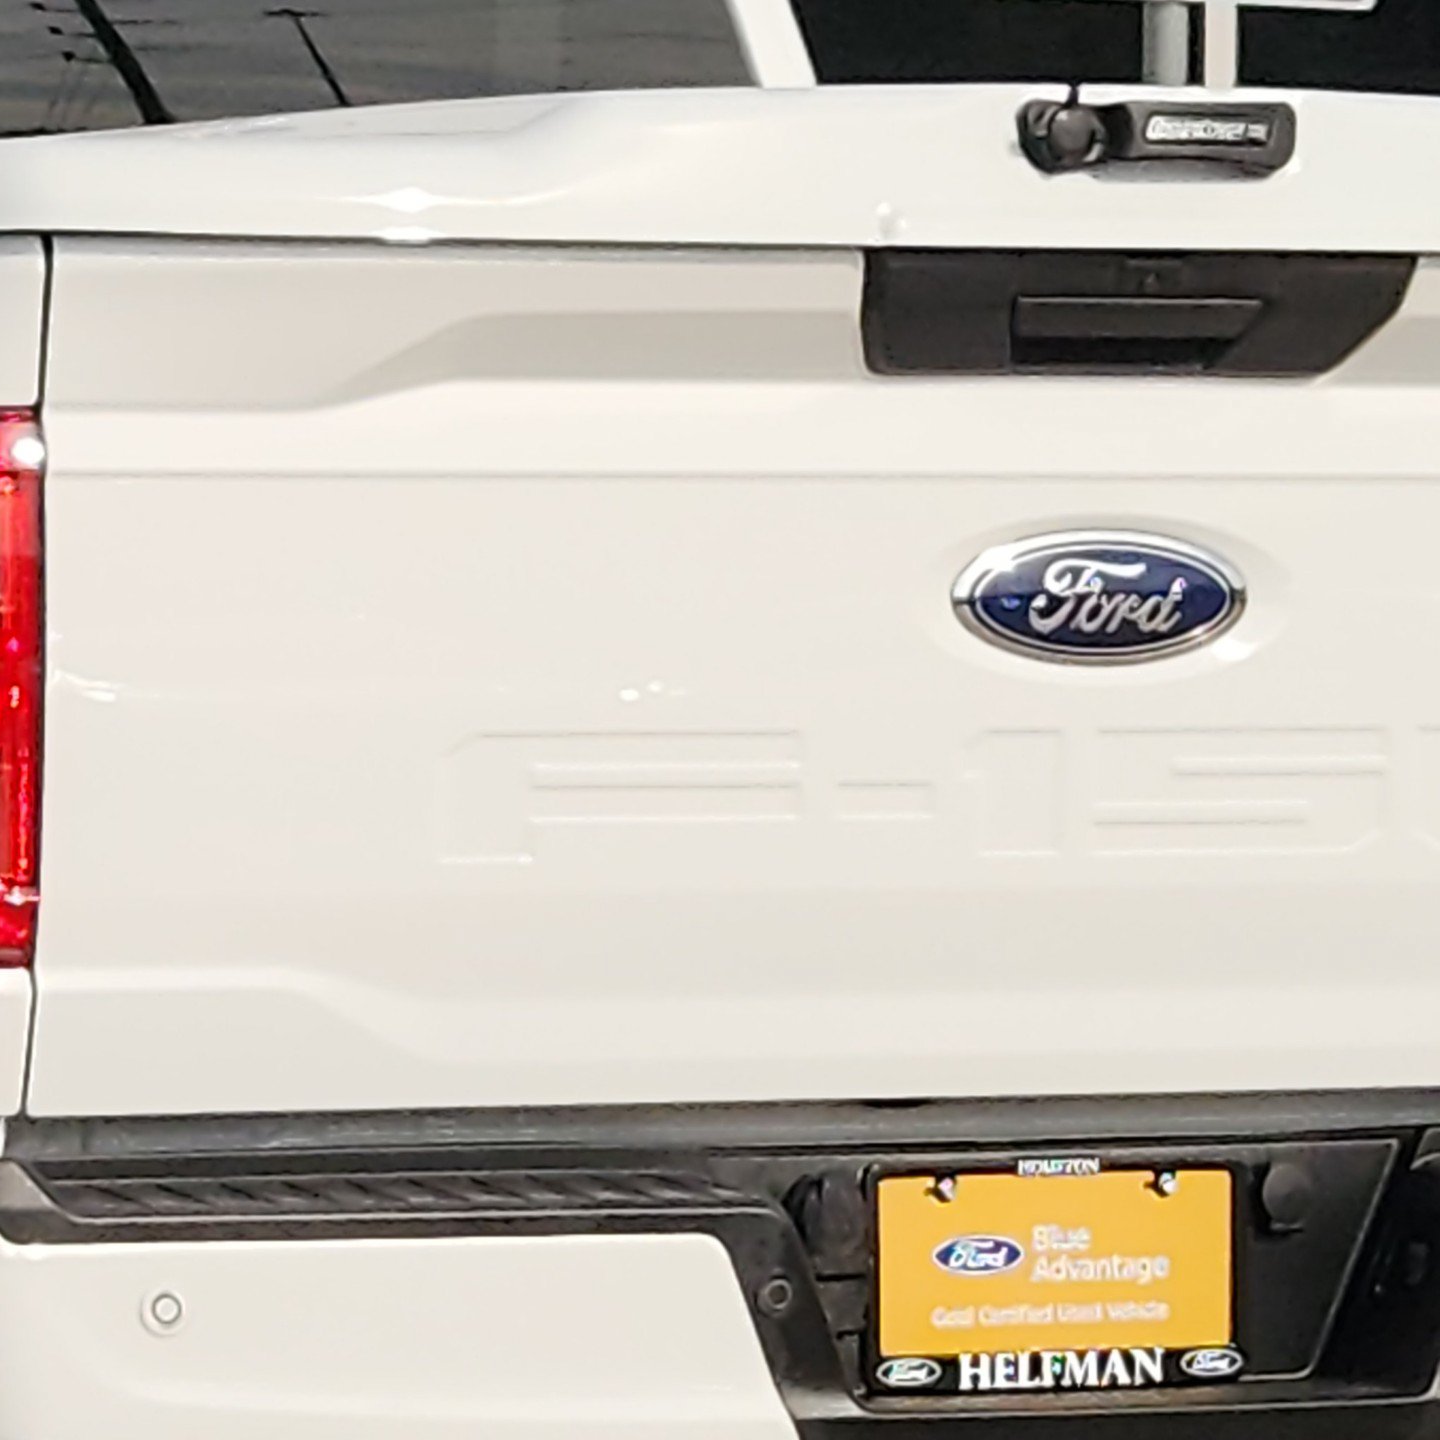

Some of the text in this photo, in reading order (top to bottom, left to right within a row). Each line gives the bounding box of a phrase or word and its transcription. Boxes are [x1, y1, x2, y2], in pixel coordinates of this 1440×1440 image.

[1029, 559, 1186, 634] Ford
[1018, 1157, 1100, 1175] HOUSTON
[1032, 1225, 1090, 1250] Blue
[1031, 1253, 1169, 1284] Advantage
[959, 1347, 1165, 1390] HELFMAN
